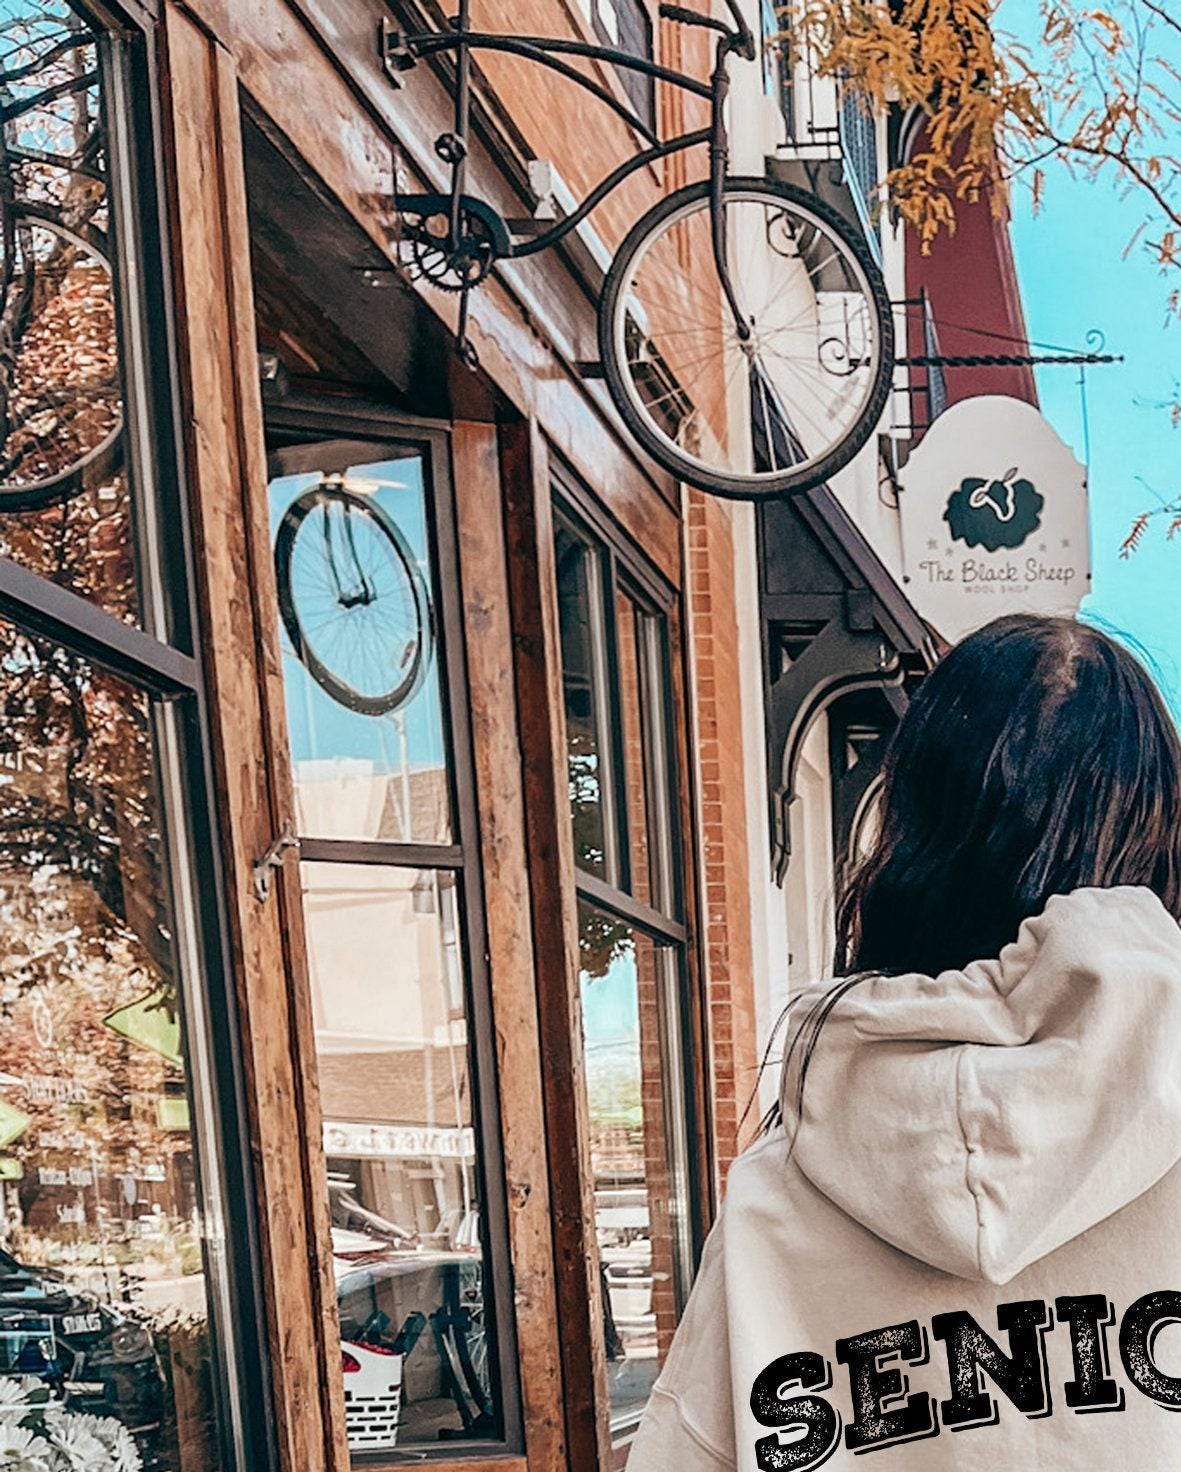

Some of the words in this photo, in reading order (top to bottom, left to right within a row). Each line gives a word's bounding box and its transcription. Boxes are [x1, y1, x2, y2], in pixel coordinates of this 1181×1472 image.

[918, 560, 955, 583] The
[961, 558, 1018, 583] Black
[1024, 557, 1076, 586] Sheep
